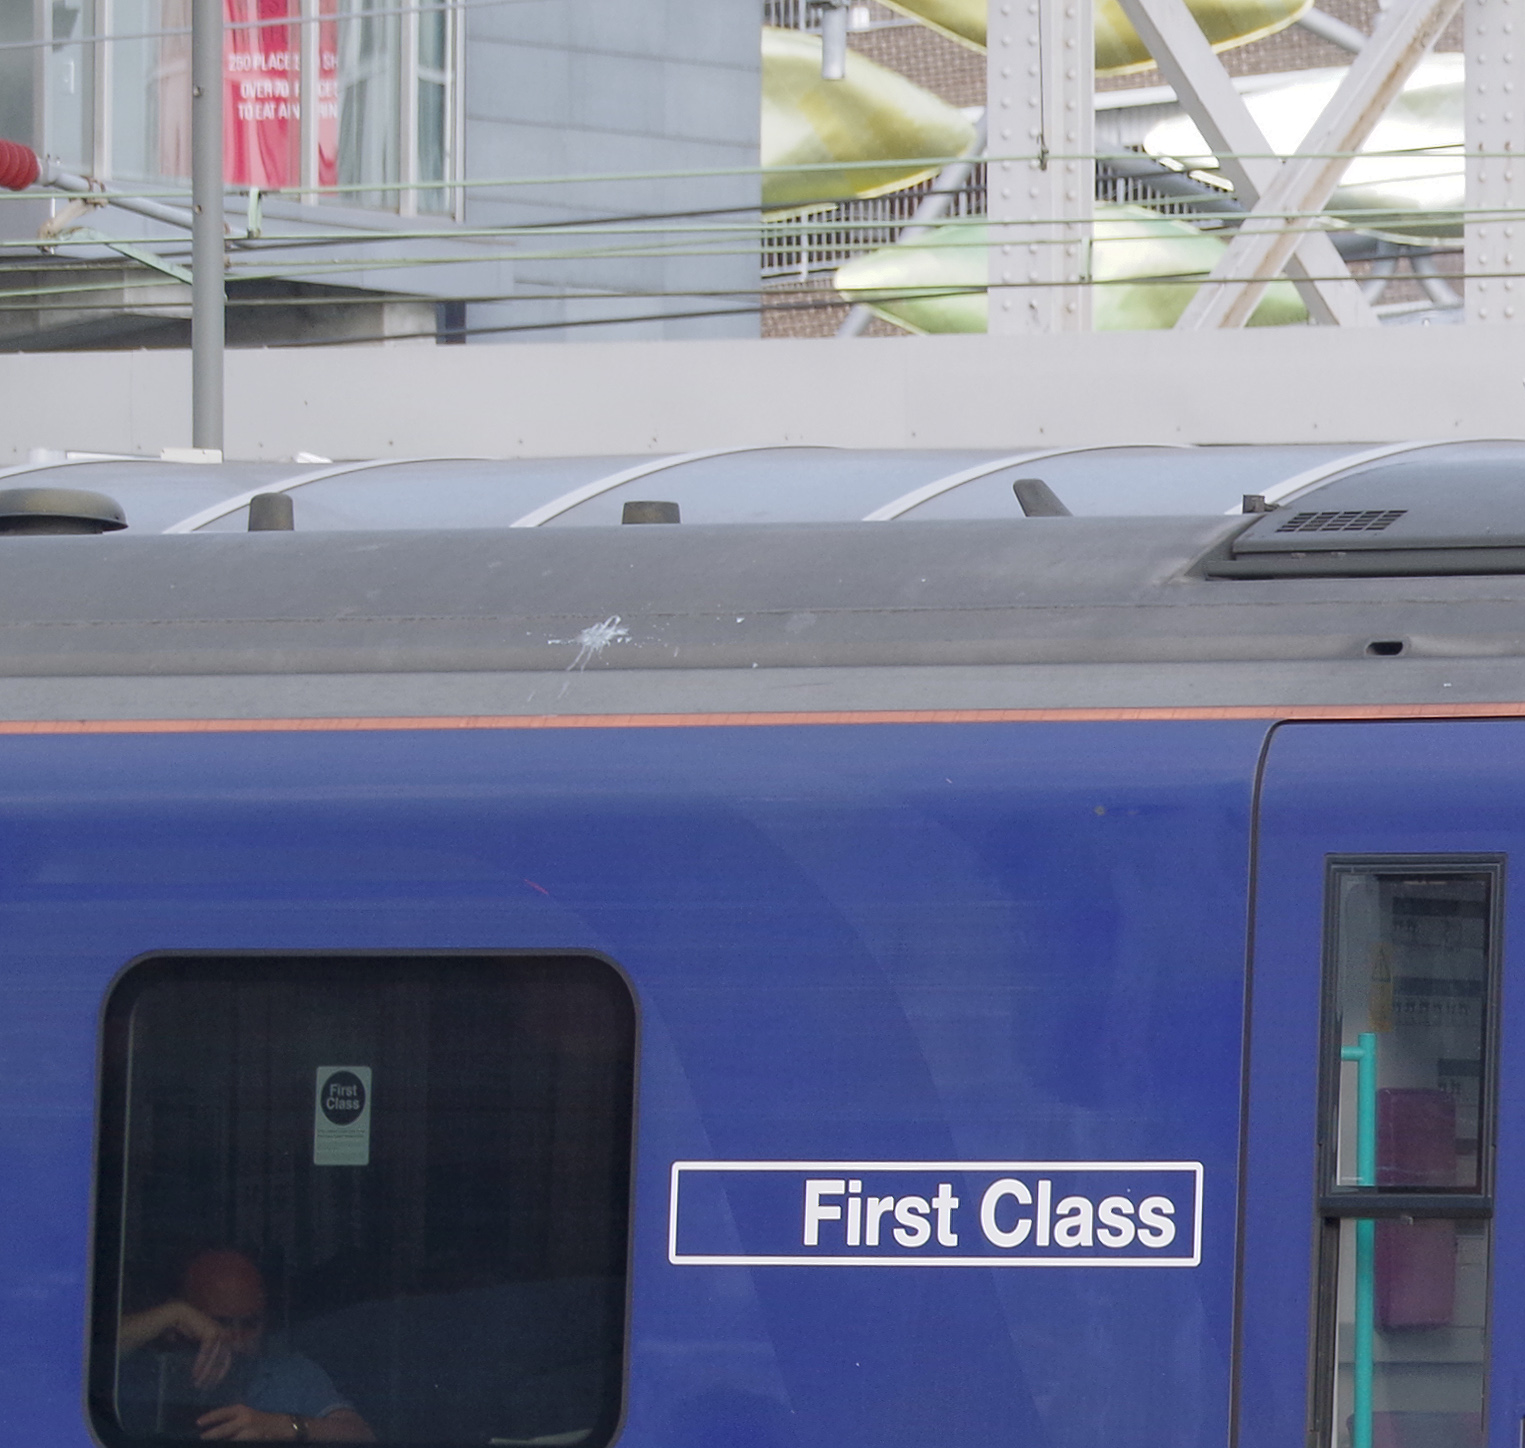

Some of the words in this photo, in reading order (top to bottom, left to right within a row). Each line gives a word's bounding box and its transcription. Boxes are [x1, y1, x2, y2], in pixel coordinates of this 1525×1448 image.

[330, 1083, 357, 1097] First
[326, 1097, 360, 1110] Class
[804, 1180, 958, 1247] First
[981, 1179, 1176, 1248] Class
